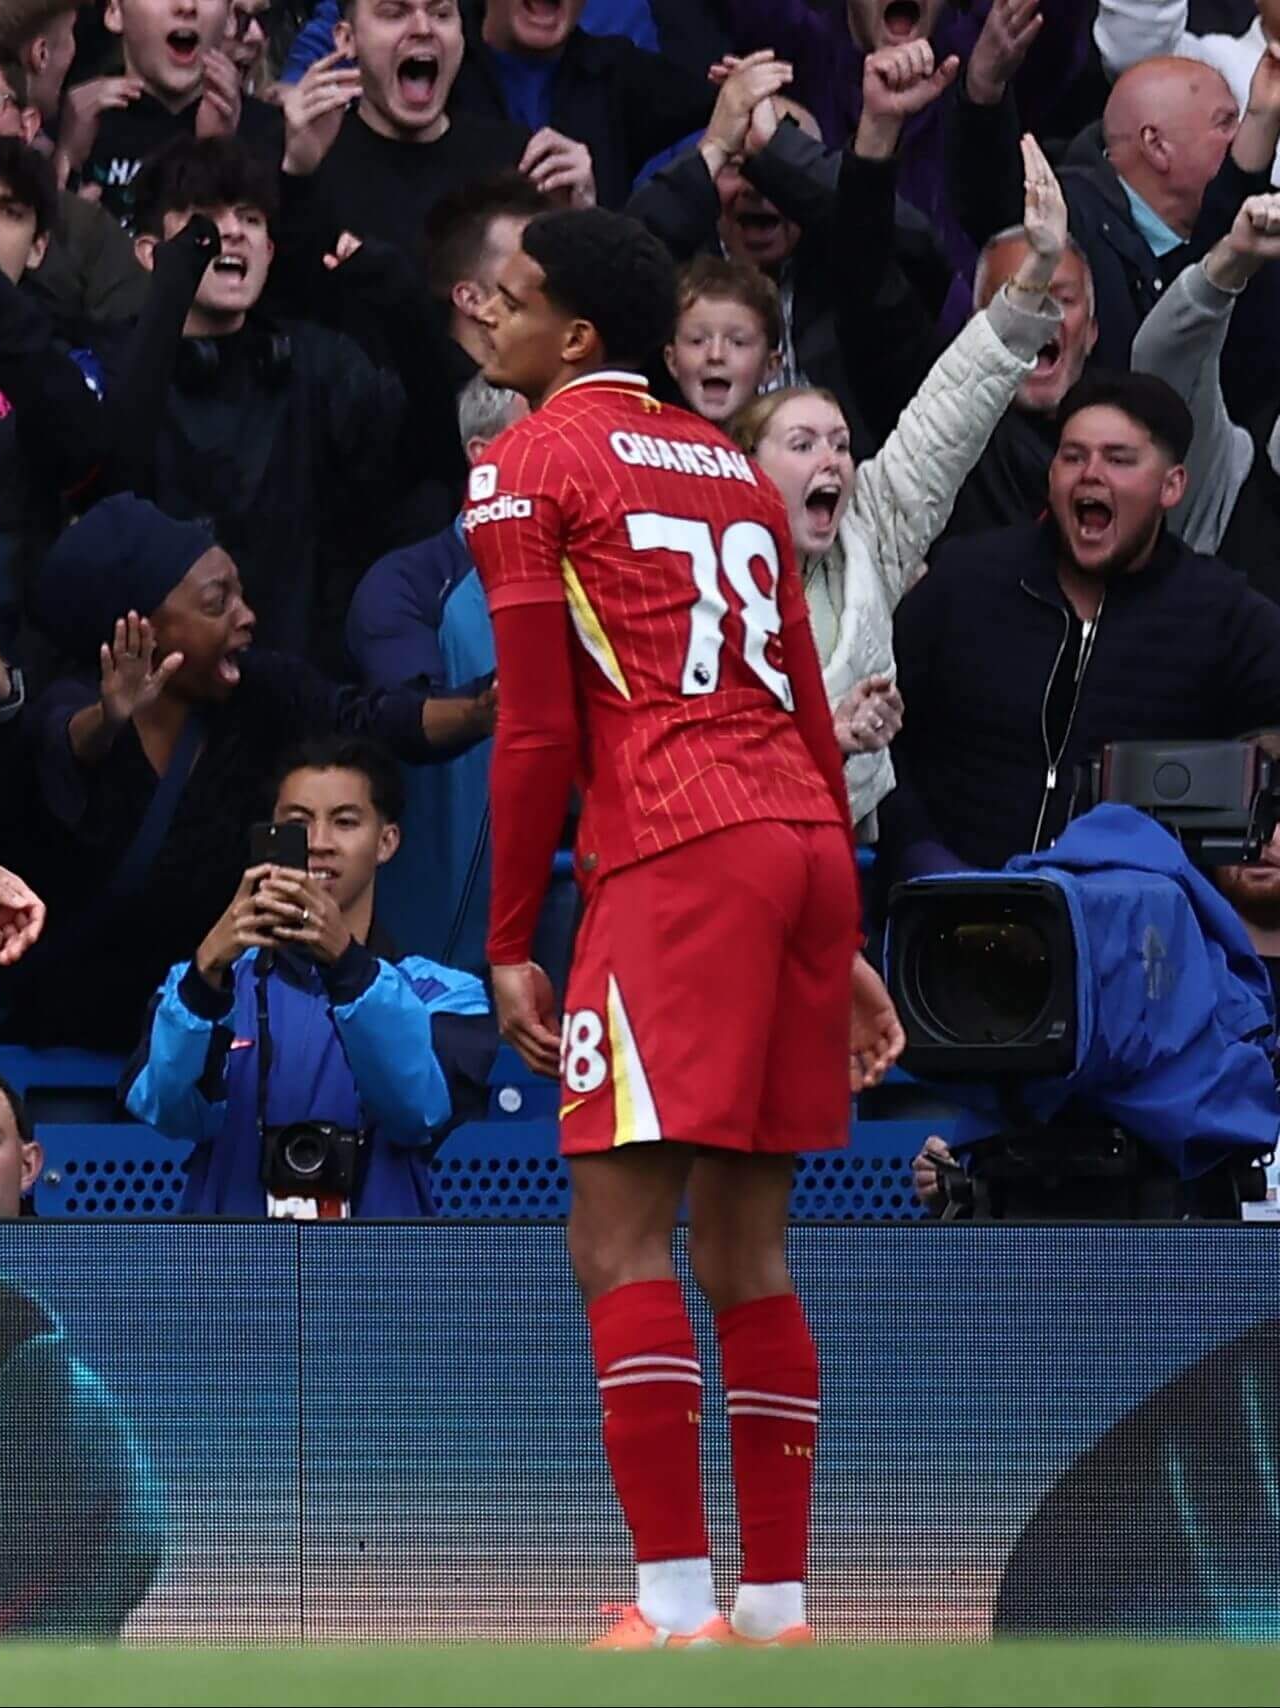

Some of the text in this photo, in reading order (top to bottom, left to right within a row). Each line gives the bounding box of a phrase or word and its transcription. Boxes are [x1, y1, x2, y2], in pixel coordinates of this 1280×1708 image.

[462, 495, 532, 534] pedia
[625, 512, 795, 712] 78
[559, 1008, 608, 1094] 8
